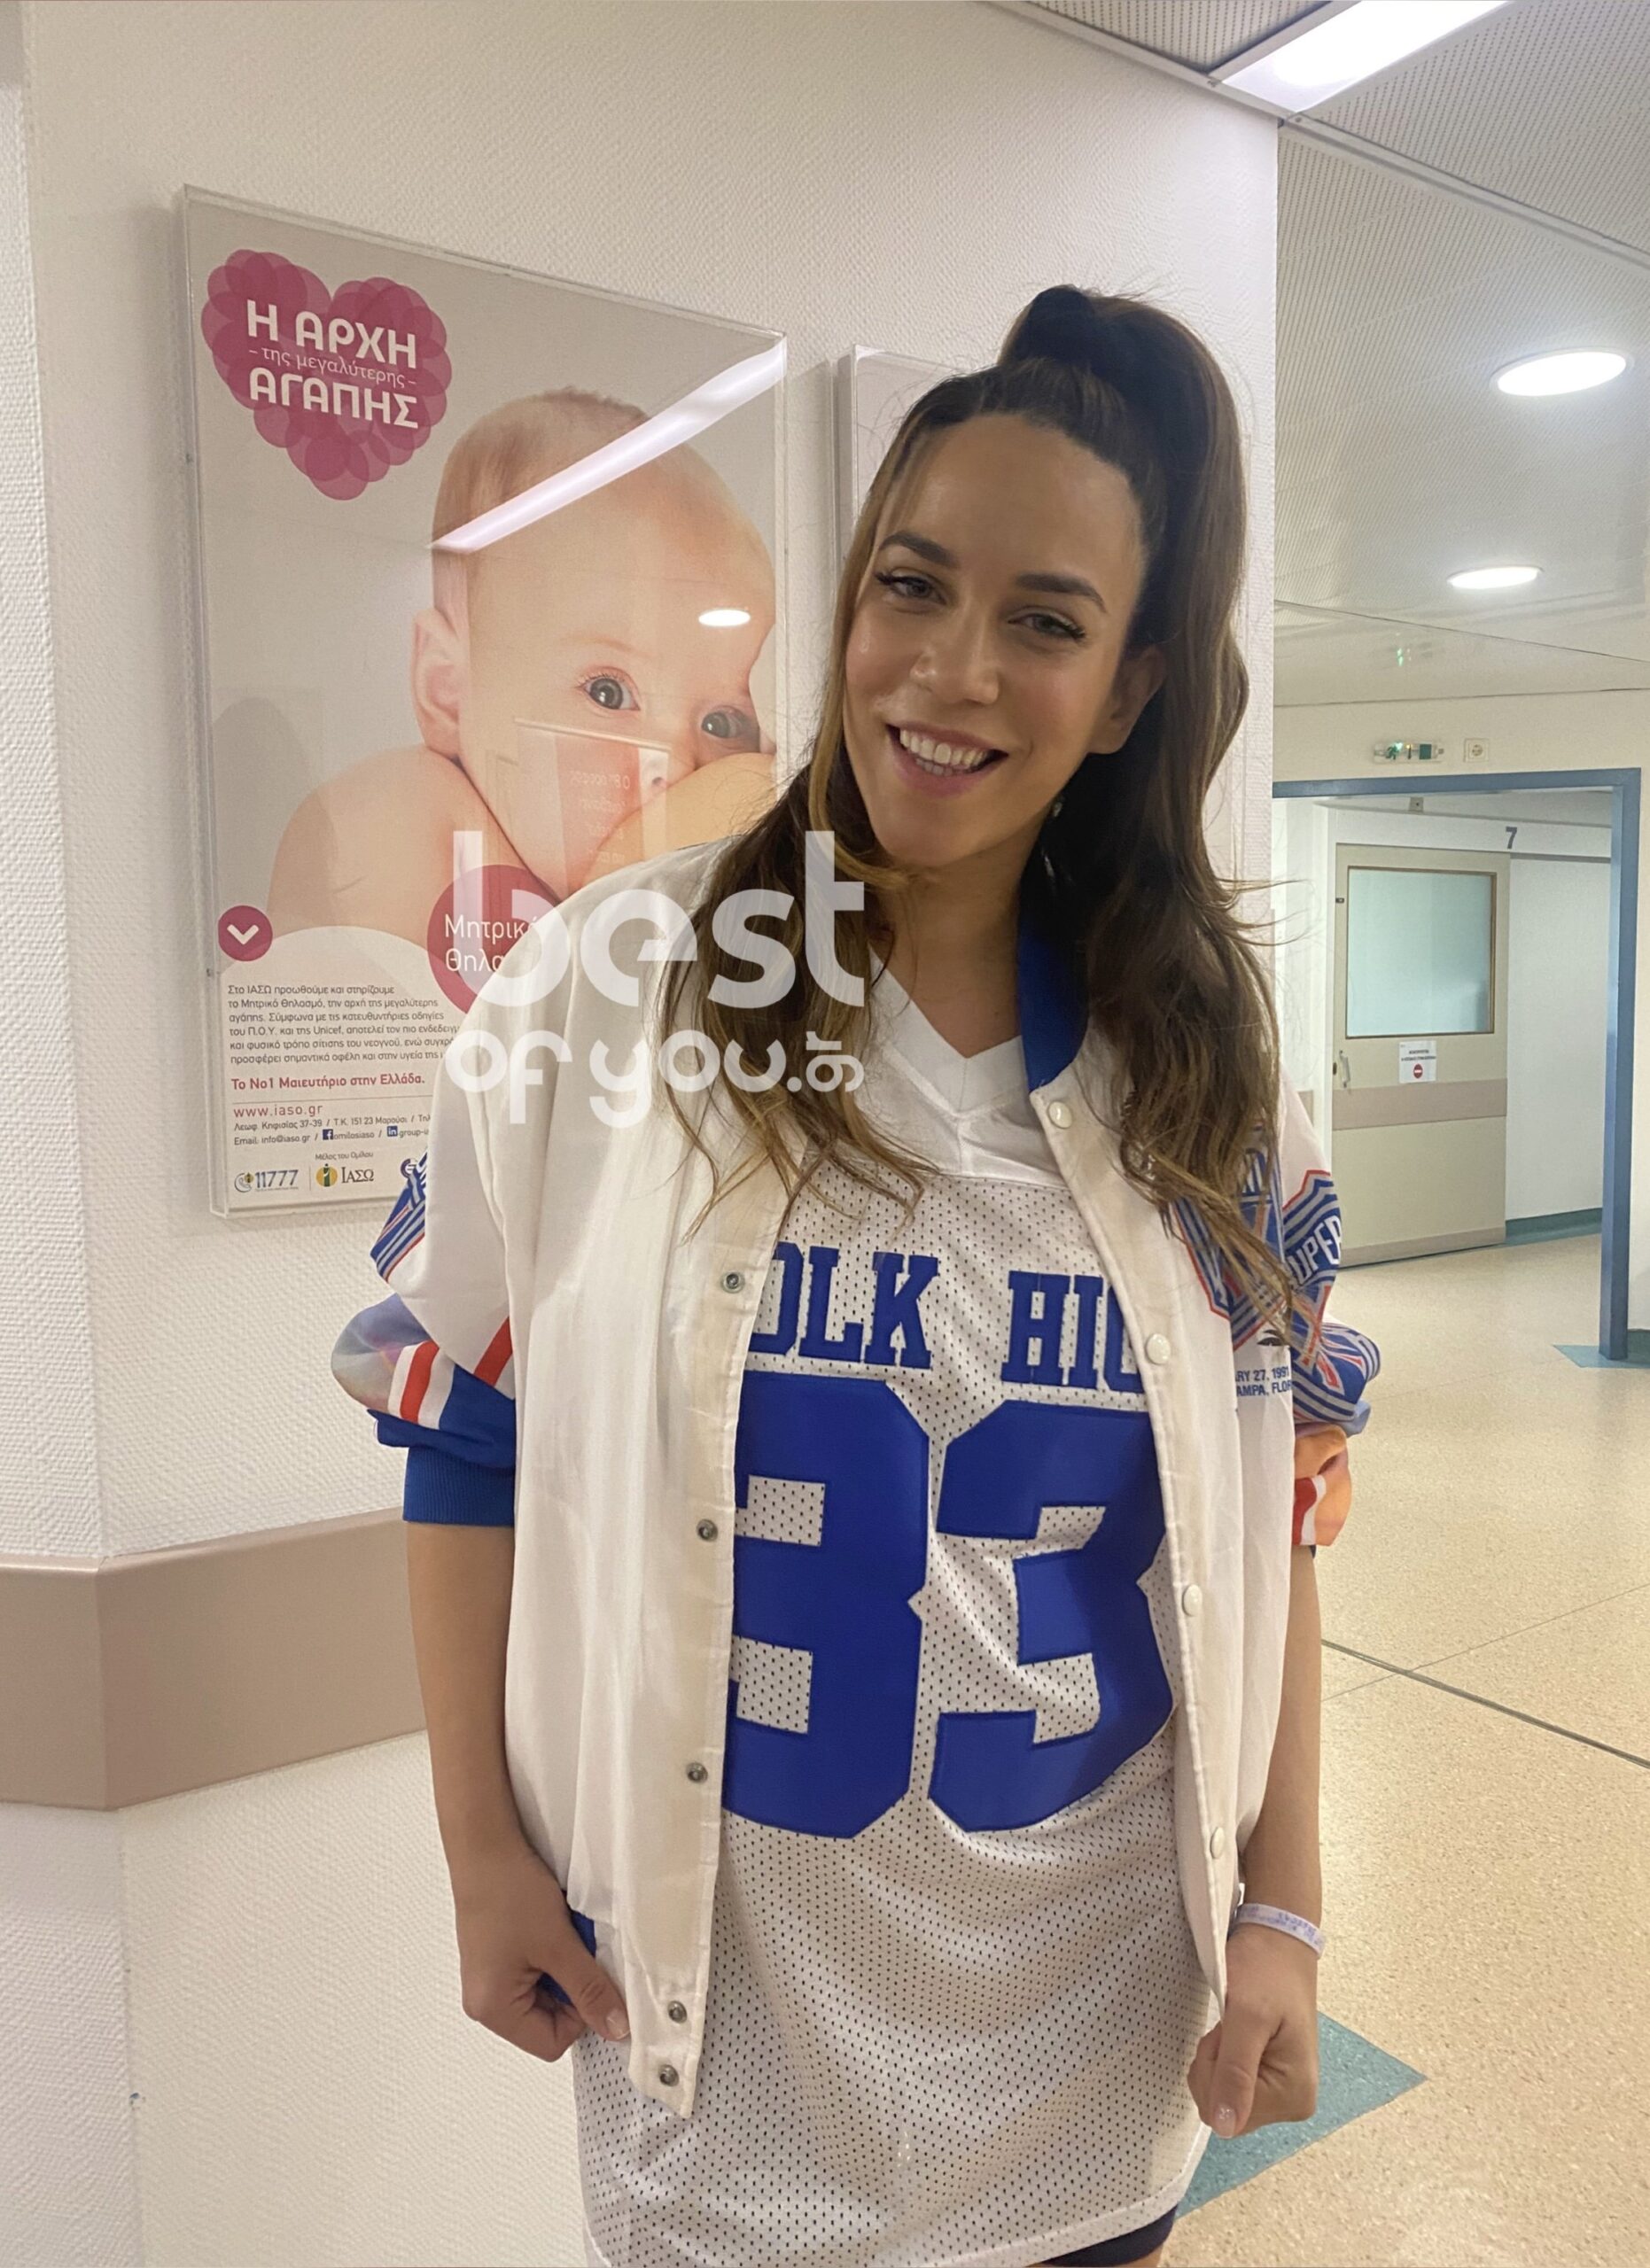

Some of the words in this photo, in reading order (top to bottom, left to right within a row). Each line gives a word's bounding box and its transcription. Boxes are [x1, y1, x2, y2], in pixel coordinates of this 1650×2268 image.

[246, 299, 278, 341] Η
[295, 311, 416, 369] ΑΡΧΗ
[261, 346, 291, 366] της
[297, 354, 405, 388] μεγαλύτερης
[249, 367, 418, 429] ΑΓΑΠΗΣ
[1506, 826, 1518, 850] 7
[228, 985, 245, 994] Στο
[247, 985, 272, 994] ΙΑΣΩ
[274, 985, 329, 995] προωθούμε
[346, 984, 394, 995] στηρίζουμε
[241, 998, 279, 1010] Μητρικό
[328, 999, 342, 1008] την
[345, 998, 366, 1008] αρχή
[384, 998, 439, 1008] μεγαλύτερης
[269, 1013, 314, 1023] Σύμφωνα
[315, 1014, 327, 1022] με
[342, 1011, 409, 1021] κατευθυντήριες
[411, 1011, 445, 1021] οδηγίες
[346, 1025, 385, 1035] αποτελεί
[230, 1041, 245, 1050] και
[246, 1040, 281, 1052] φυσικό
[283, 1039, 310, 1050] τρόπο
[312, 1038, 345, 1048] σίτισης
[404, 1037, 422, 1046] ενώ
[230, 1054, 282, 1066] προσφέρει
[284, 1052, 331, 1063] σημαντικά
[331, 1052, 360, 1062] οφέλη
[400, 1051, 423, 1060] υγεία
[231, 1078, 246, 1090] Το
[279, 1075, 347, 1089] Μαιευτήριο
[350, 1076, 377, 1086] στην
[380, 1073, 425, 1085] Ελλάδα.
[234, 1104, 323, 1118] www.iaso.gr
[262, 1121, 298, 1130] Κηφισίας
[300, 1119, 323, 1128] 37-39
[376, 1116, 407, 1125] Μαρούσι
[261, 1134, 310, 1144] info@iaso.gr
[334, 1130, 375, 1139] omilosiaso
[255, 1169, 299, 1188] 11777
[341, 1167, 375, 1184] ΙΑΣΩ
[721, 1370, 1173, 1839] 33
